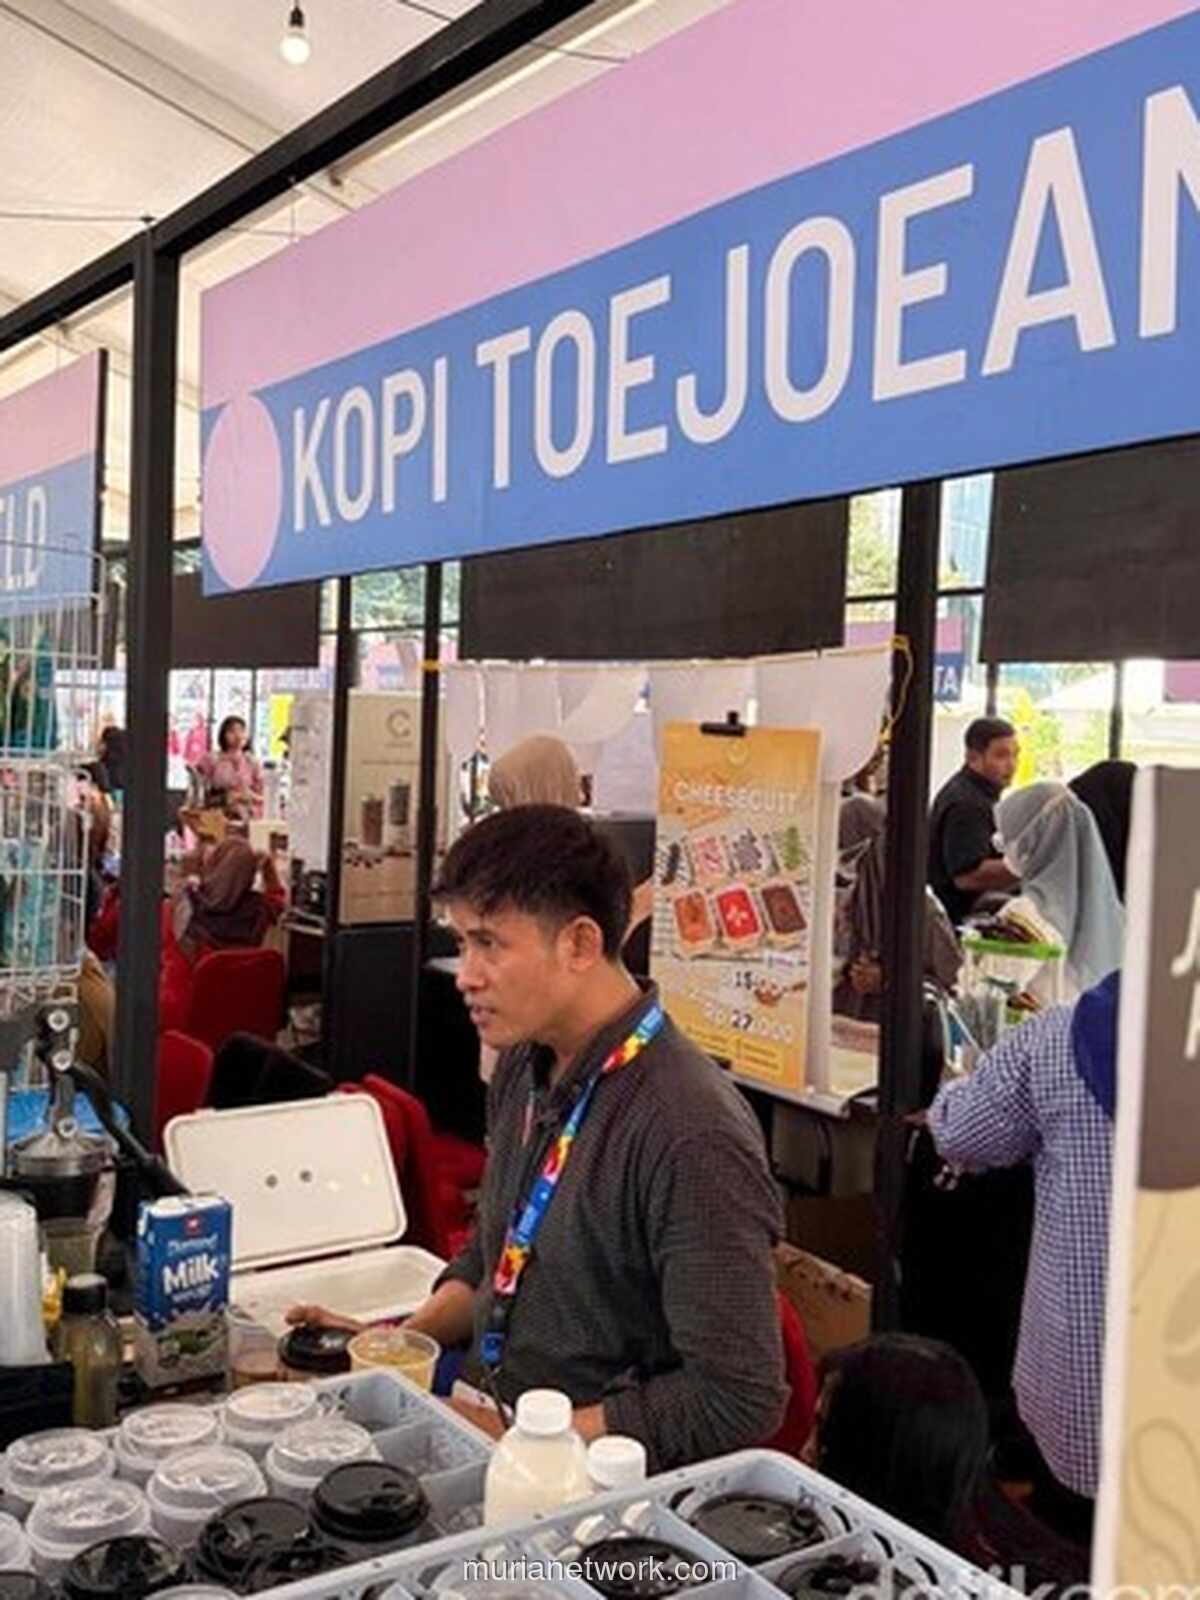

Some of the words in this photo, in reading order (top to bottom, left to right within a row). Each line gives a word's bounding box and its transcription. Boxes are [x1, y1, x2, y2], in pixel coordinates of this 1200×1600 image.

[293, 356, 448, 532] KOPI
[0, 486, 47, 590] LD
[163, 1253, 219, 1295] Milk
